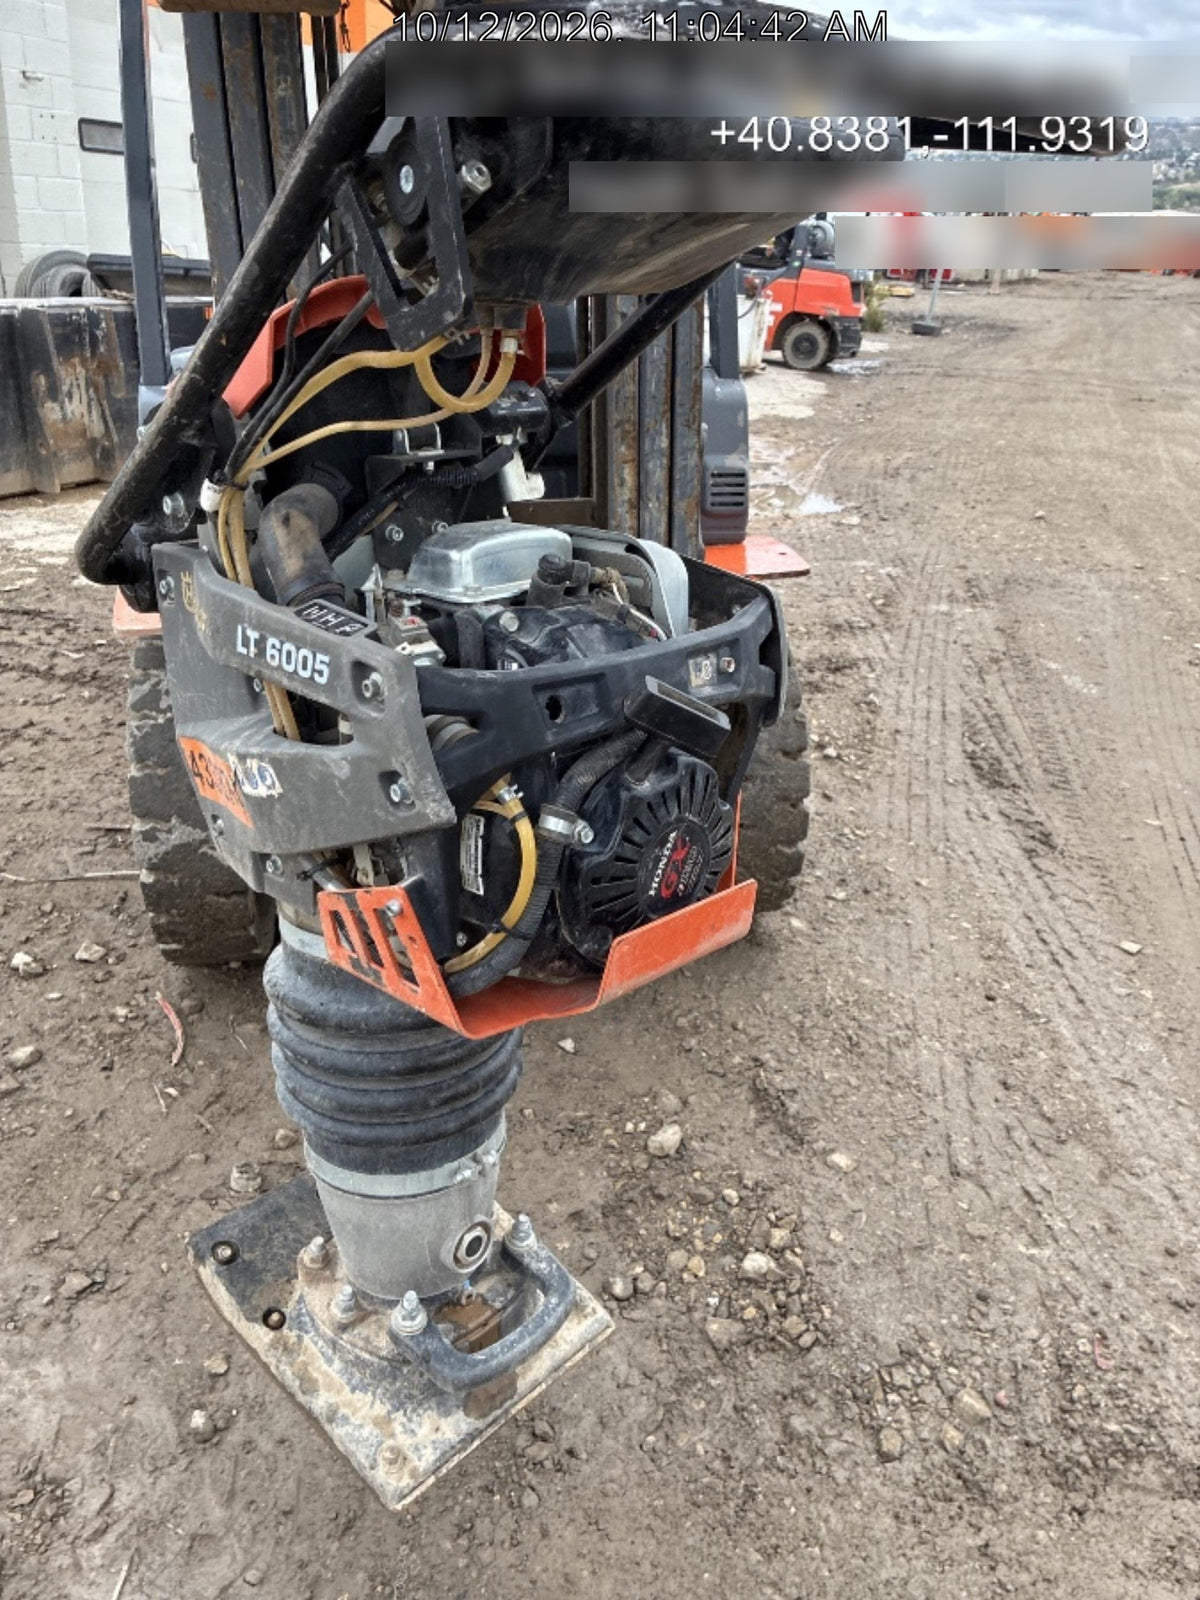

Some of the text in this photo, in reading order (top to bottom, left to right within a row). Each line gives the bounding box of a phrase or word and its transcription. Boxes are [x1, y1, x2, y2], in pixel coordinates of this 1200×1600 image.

[236, 624, 330, 685] LT 6005
[649, 830, 677, 896] HONDA
